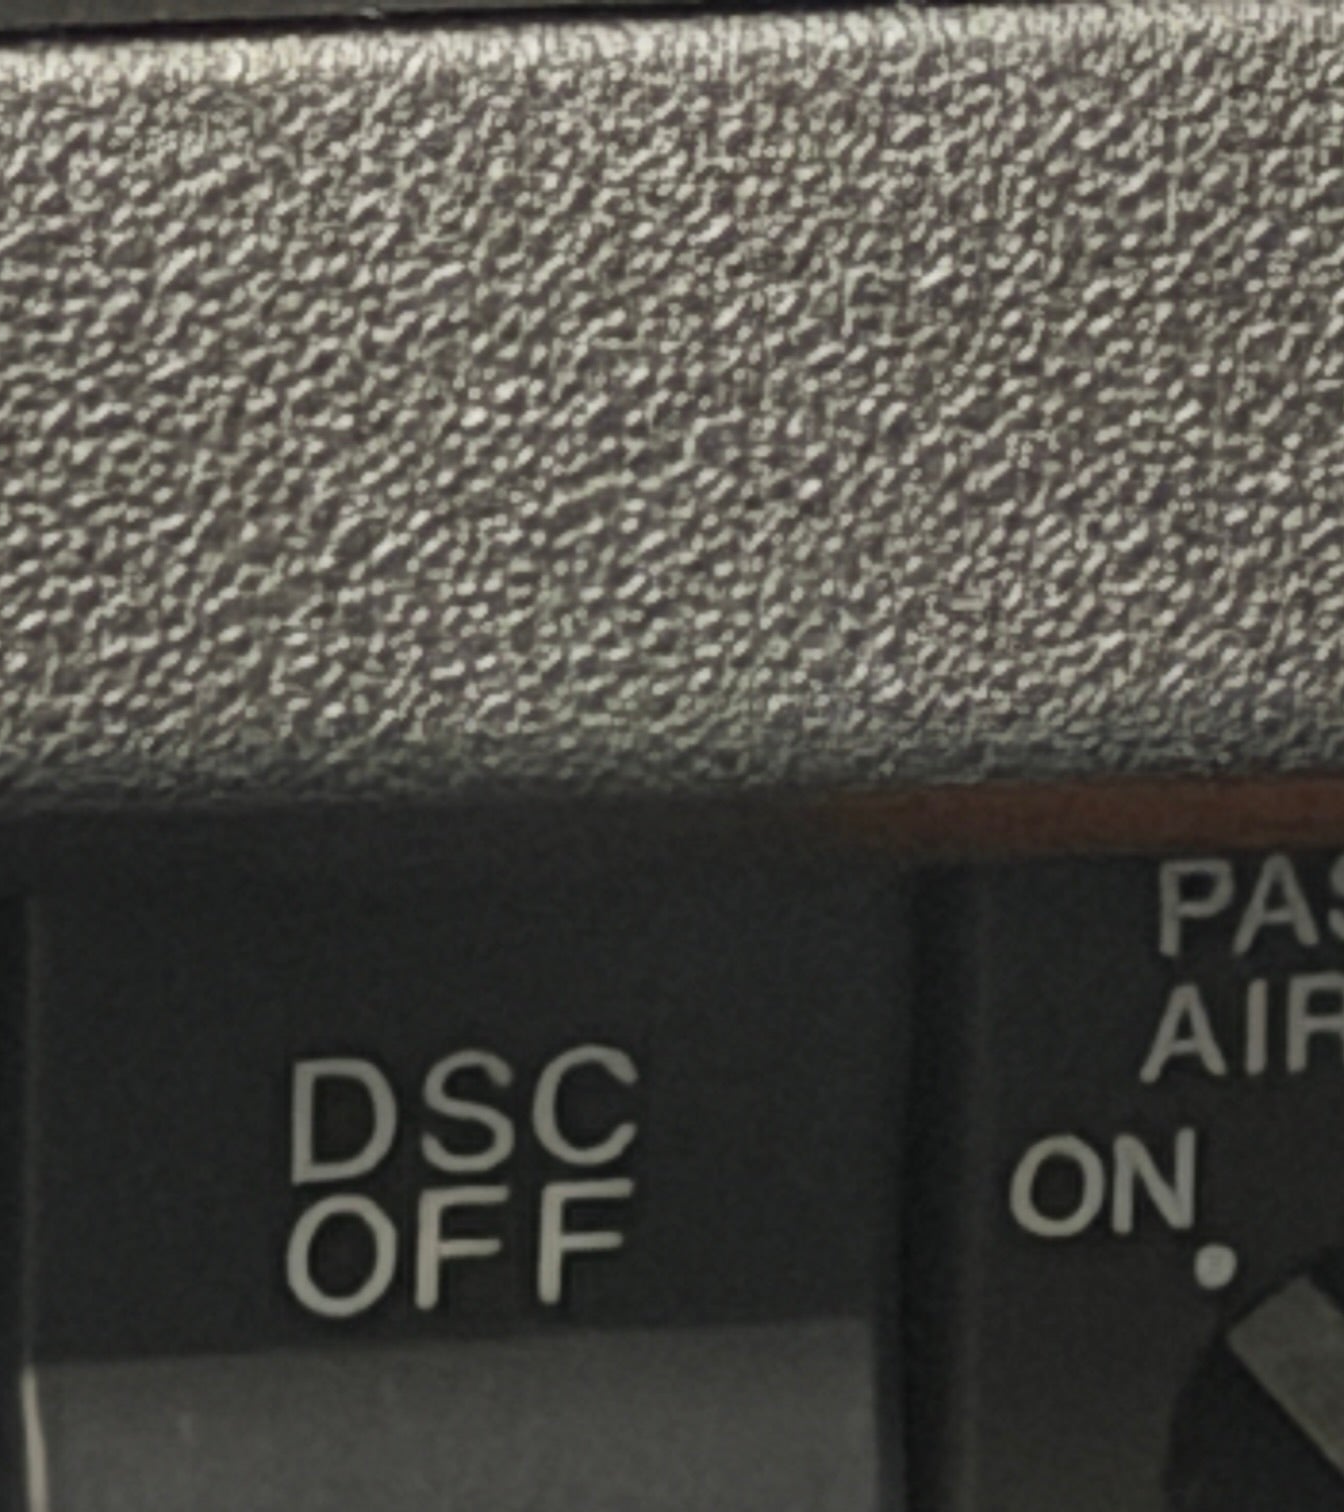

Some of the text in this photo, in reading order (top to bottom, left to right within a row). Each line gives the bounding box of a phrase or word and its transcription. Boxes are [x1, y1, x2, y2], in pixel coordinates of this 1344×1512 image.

[291, 1044, 638, 1185] DSC
[1010, 1128, 1197, 1237] ON
[287, 1177, 634, 1318] OFF
